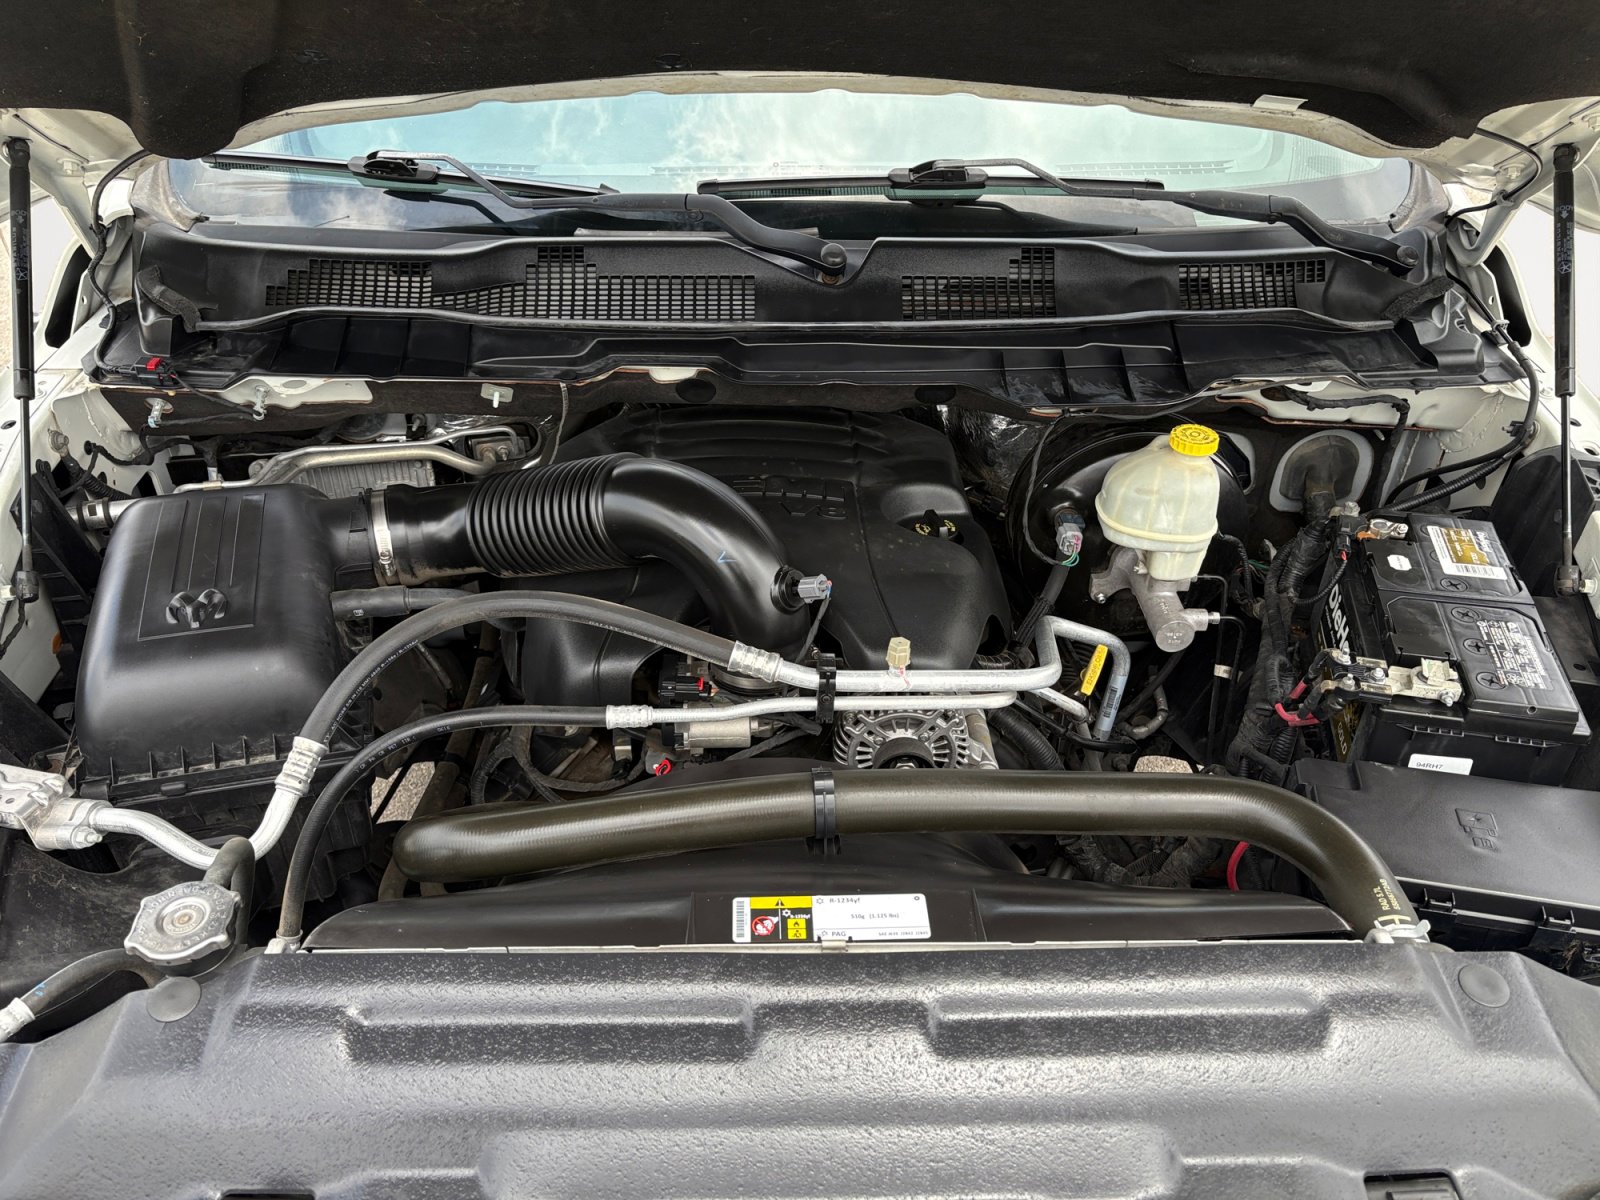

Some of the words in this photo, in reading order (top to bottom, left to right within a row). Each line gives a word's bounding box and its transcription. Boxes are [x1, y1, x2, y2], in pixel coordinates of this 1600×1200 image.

[829, 896, 861, 906] R-1234yf
[850, 913, 865, 921] 510g
[831, 930, 847, 938] PAG
